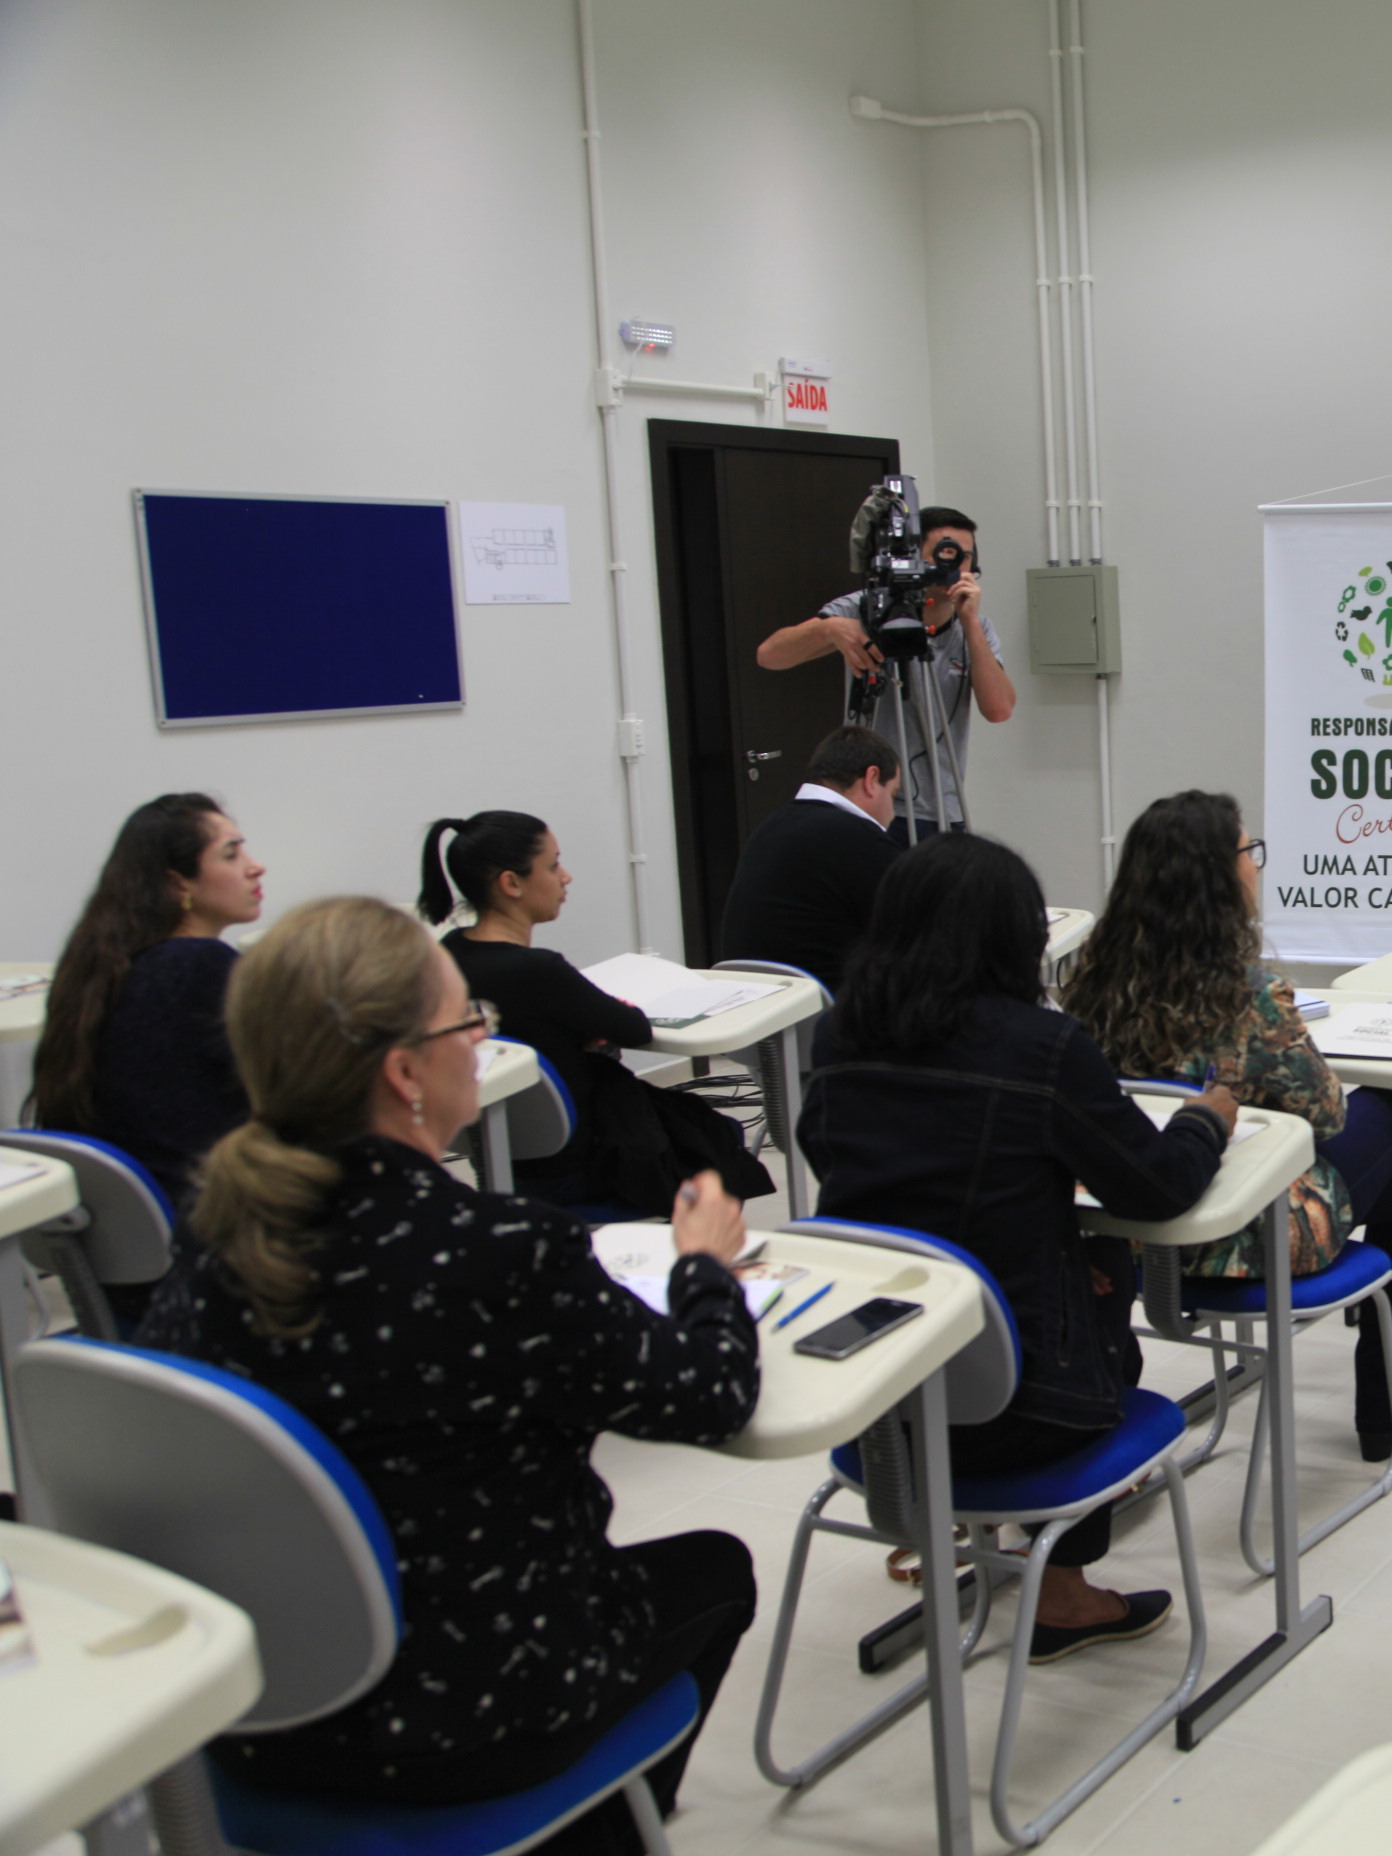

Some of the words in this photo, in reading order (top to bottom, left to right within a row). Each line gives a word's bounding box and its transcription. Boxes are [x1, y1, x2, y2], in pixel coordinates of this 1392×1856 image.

[787, 378, 828, 411] SAÍDA
[1303, 854, 1357, 876] UMA
[1278, 886, 1359, 908] VALOR
